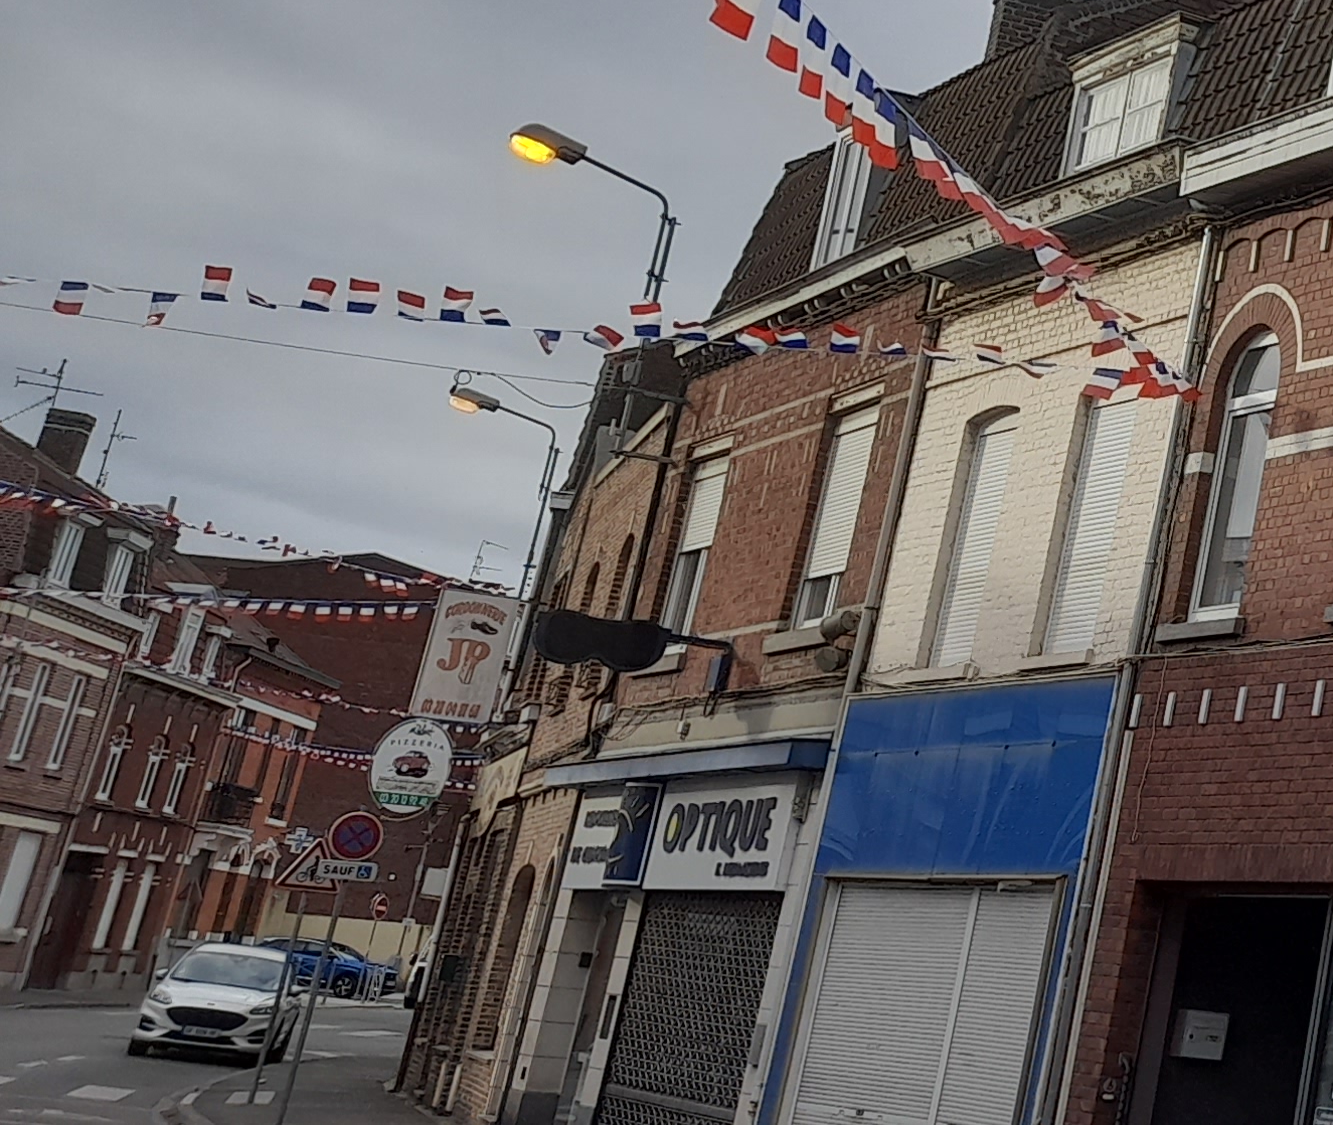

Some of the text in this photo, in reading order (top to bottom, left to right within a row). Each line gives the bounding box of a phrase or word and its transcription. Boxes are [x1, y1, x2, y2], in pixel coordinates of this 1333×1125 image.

[390, 738, 445, 751] PIZZERIA
[663, 797, 778, 859] OPTIQUE
[323, 864, 355, 875] SAUF
